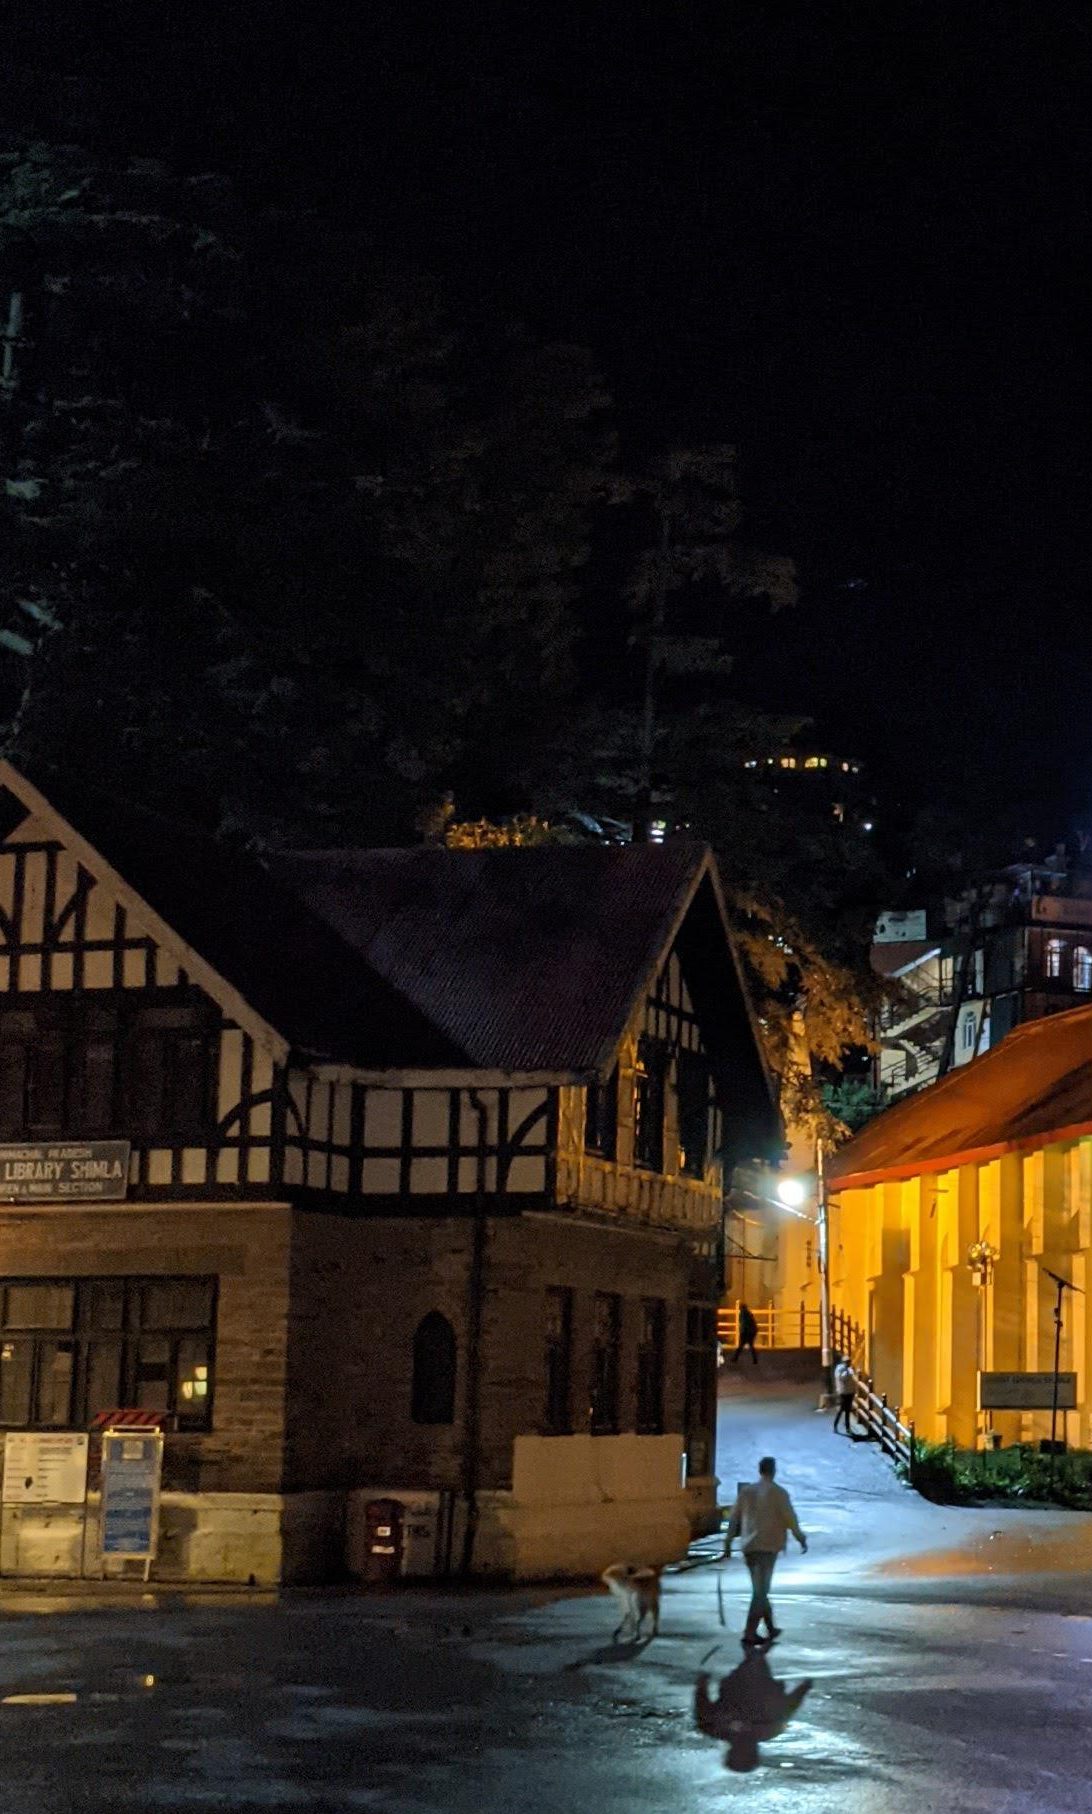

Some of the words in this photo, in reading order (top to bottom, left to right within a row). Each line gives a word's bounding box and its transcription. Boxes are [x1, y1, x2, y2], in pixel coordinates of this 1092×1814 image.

[5, 1161, 64, 1181] LIBRARY
[70, 1160, 123, 1179] SHIMLA
[58, 1182, 103, 1193] SECTION
